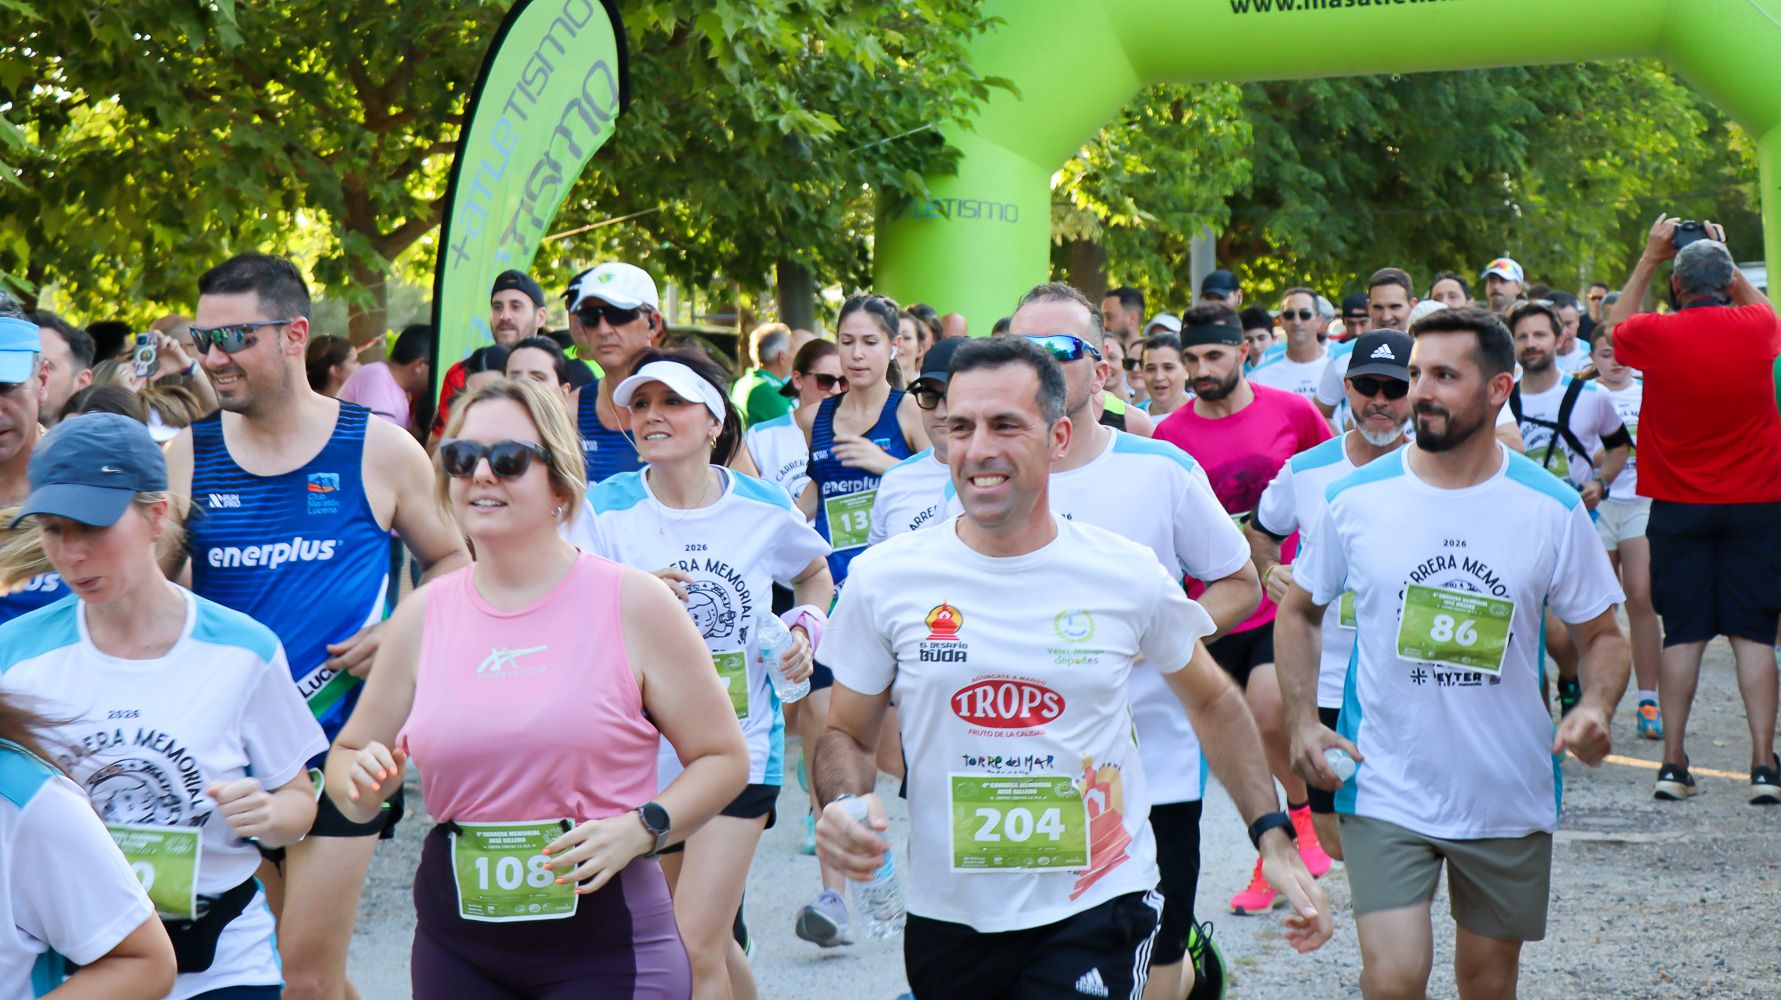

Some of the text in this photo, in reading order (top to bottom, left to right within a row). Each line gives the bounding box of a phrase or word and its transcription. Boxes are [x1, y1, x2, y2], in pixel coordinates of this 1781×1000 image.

[208, 536, 337, 570] enerplus
[685, 544, 708, 552] 2026
[1443, 539, 1467, 548] 2026
[704, 557, 752, 622] MEMORIAL
[1429, 613, 1478, 647] 86
[956, 683, 1060, 719] TROPS
[968, 728, 993, 738] FRUTO
[133, 728, 204, 811] MEMORIAL
[973, 807, 1066, 843] 204
[475, 854, 555, 890] 108
